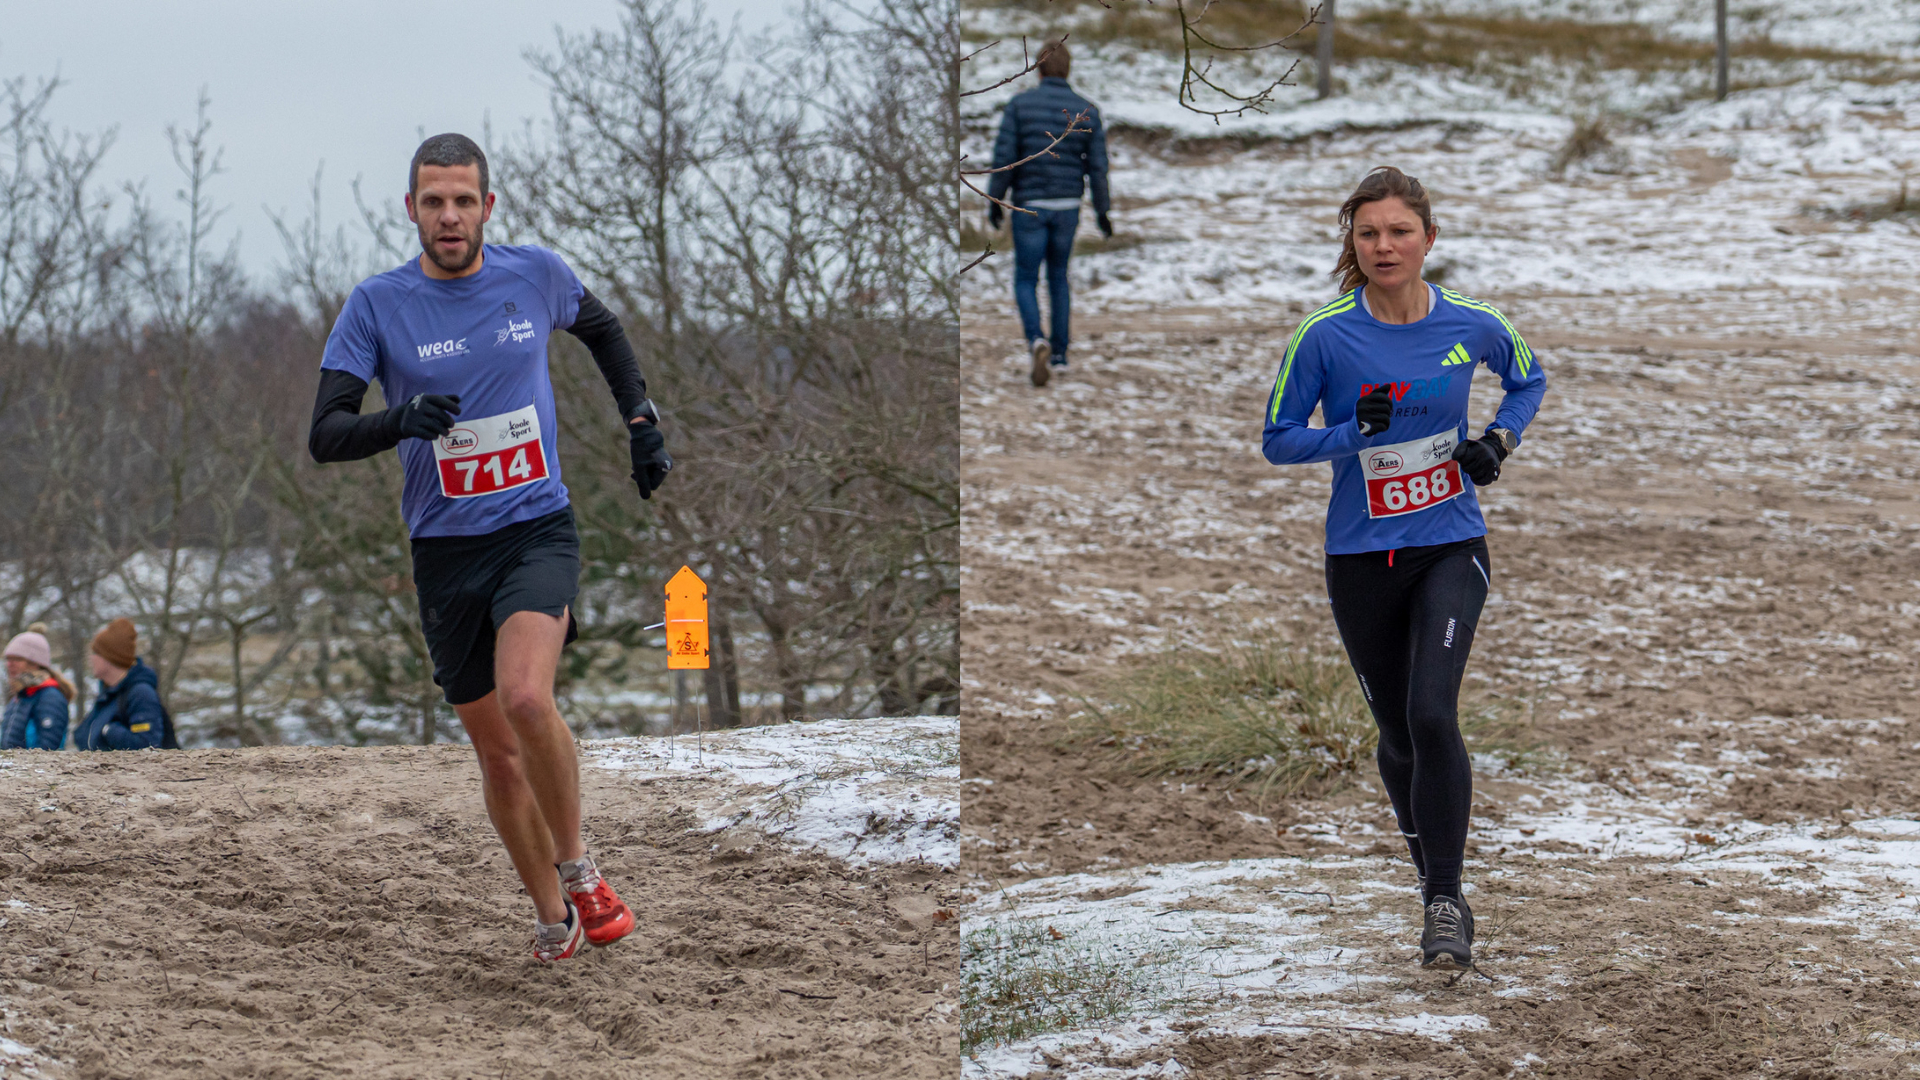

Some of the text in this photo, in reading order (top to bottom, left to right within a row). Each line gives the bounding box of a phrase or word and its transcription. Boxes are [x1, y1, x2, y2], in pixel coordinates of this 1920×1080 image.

[512, 329, 536, 343] Sport
[511, 426, 532, 439] Sport
[1433, 446, 1453, 459] Sport
[454, 447, 532, 492] 714
[1382, 468, 1451, 511] 688
[1443, 617, 1456, 648] FUSION
